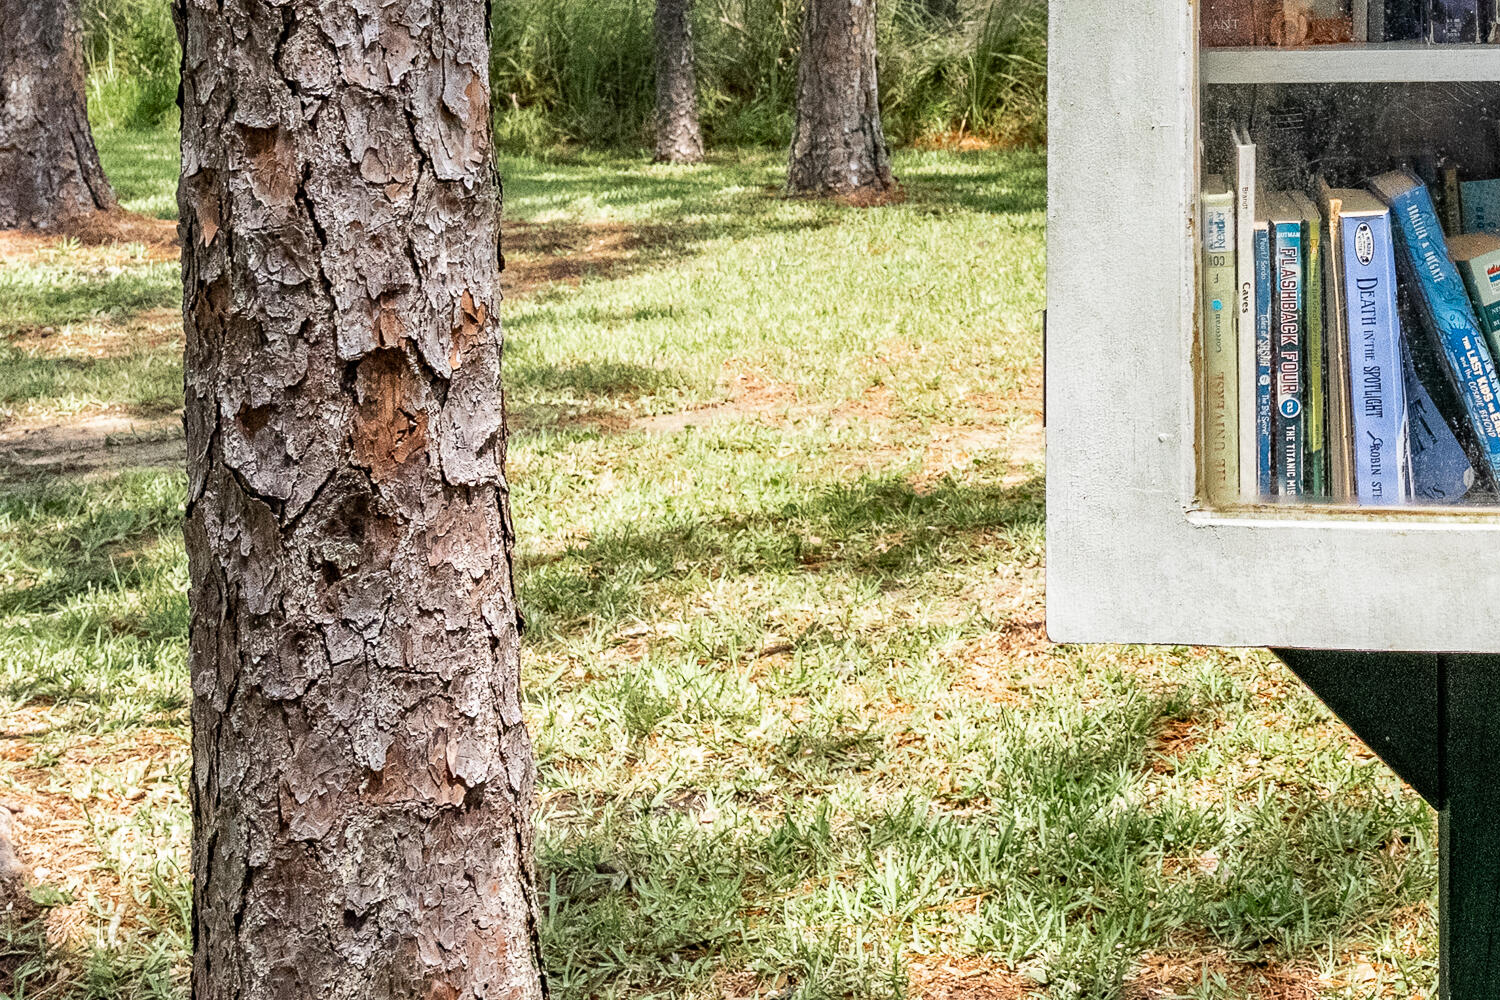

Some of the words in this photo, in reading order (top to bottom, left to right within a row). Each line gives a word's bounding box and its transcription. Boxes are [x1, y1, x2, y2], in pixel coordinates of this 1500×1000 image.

[1407, 204, 1427, 240] BRALLIER
[1424, 251, 1445, 283] HOLGATE
[1260, 260, 1268, 280] Sordo
[1242, 282, 1251, 314] Caves
[1280, 246, 1298, 346] FLASHBACK
[1214, 313, 1222, 353] Corcoran
[1364, 330, 1374, 340] IN
[1364, 341, 1375, 362] THE
[1459, 356, 1469, 368] and
[1280, 351, 1299, 394] FOUR
[1461, 335, 1471, 350] THE
[1467, 350, 1483, 377] LAST
[1477, 375, 1494, 403] KIDS
[1464, 368, 1473, 379] the
[1363, 366, 1383, 418] SPOTLIGHT
[1468, 381, 1485, 408] COSMIC
[1213, 371, 1226, 451] UNIVERSE
[1479, 409, 1497, 438] BEYOND
[1286, 425, 1296, 442] THE
[1286, 444, 1296, 477] TITANIC
[1370, 444, 1381, 475] ROBIN
